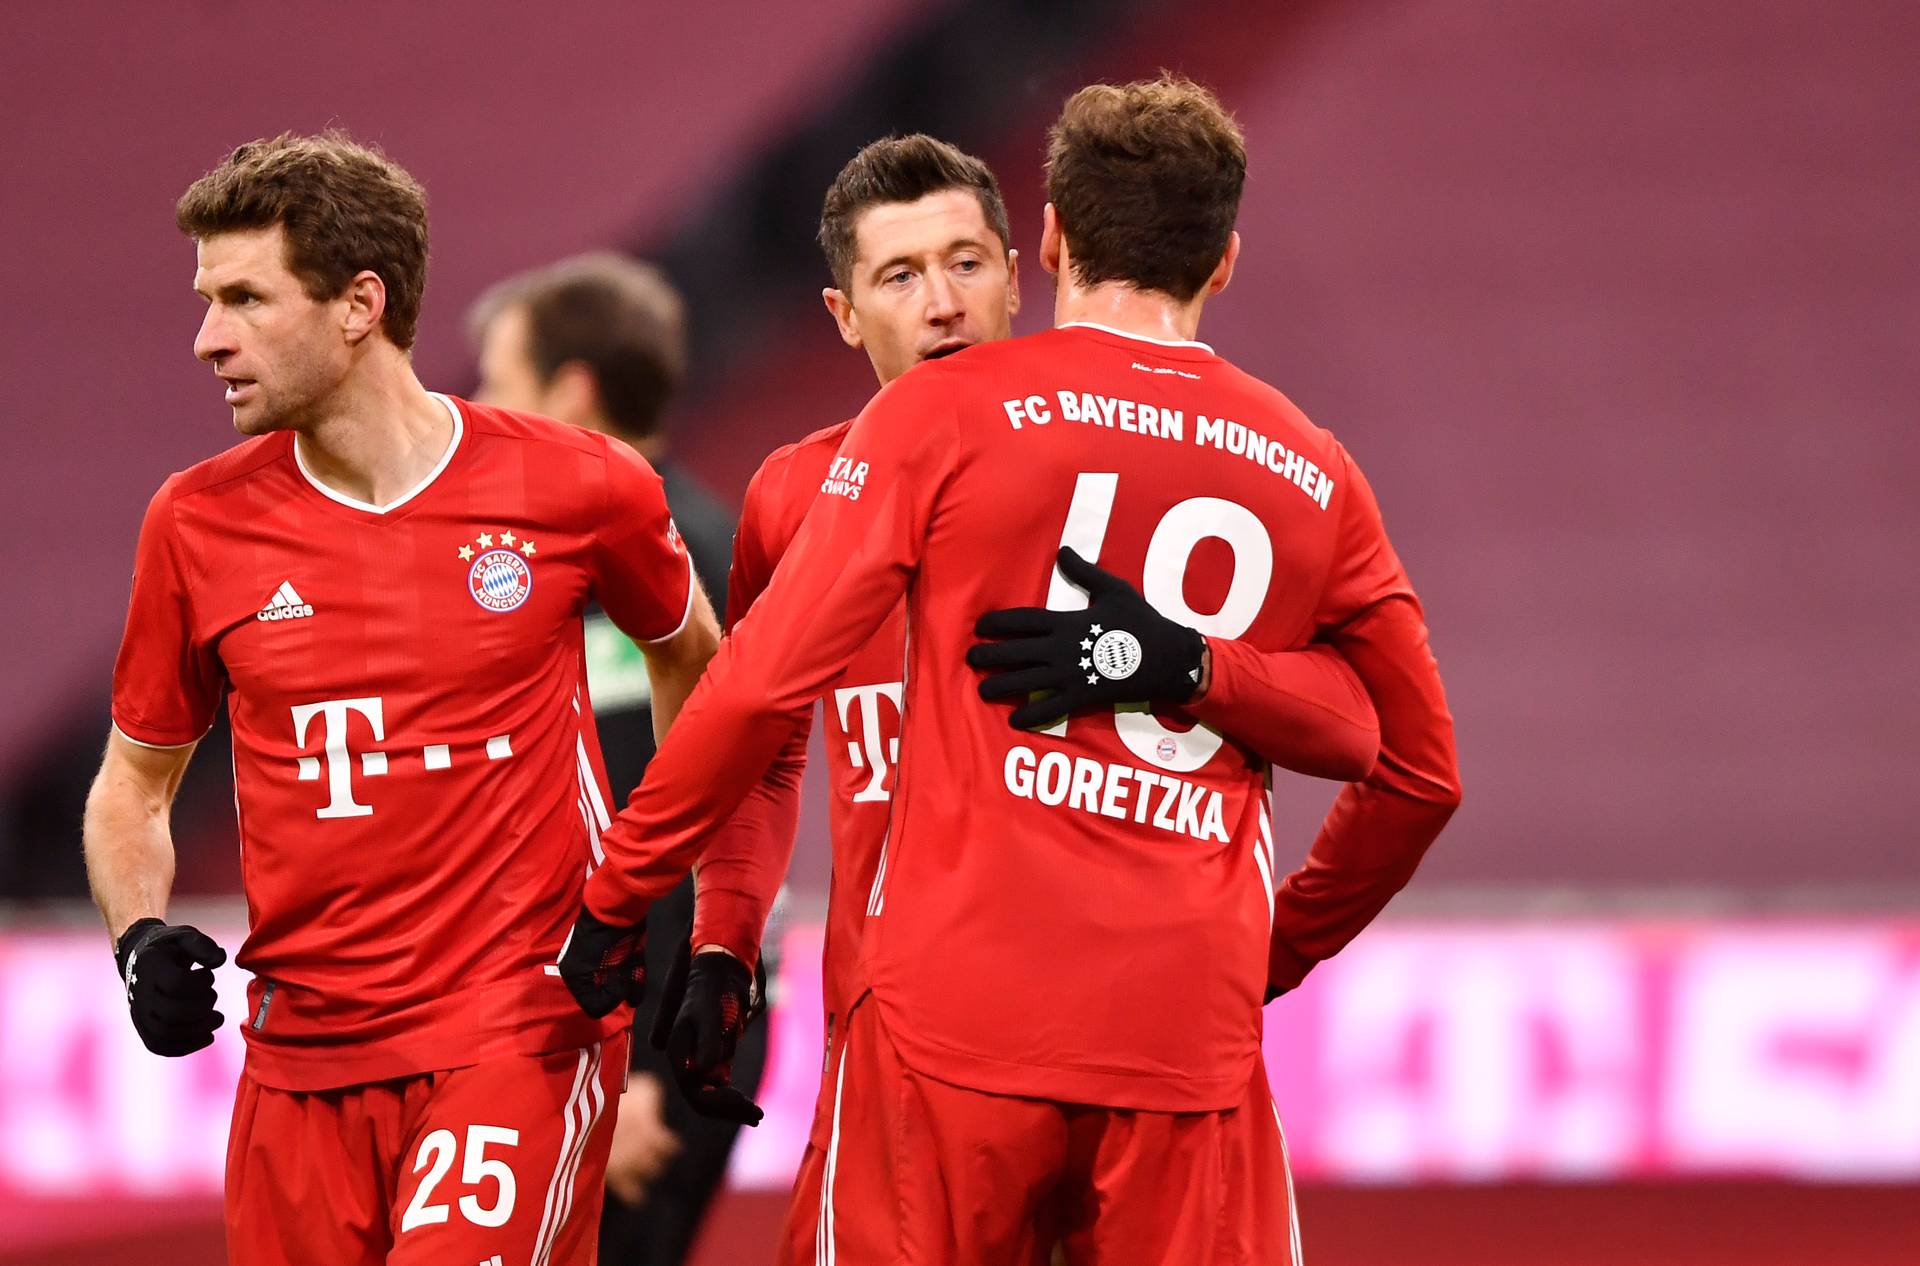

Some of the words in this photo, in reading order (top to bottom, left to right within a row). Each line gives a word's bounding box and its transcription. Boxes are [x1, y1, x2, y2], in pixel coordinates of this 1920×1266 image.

[829, 456, 870, 486] TAR
[1003, 395, 1052, 430] FC
[1056, 390, 1184, 441] BAYERN
[1195, 415, 1335, 511] MÜNCHEN
[256, 603, 314, 622] adidas
[473, 564, 486, 579] FC
[484, 553, 526, 576] BAYERN
[290, 696, 389, 819] T
[1004, 745, 1231, 844] GORETZKA
[401, 1124, 520, 1234] 25
